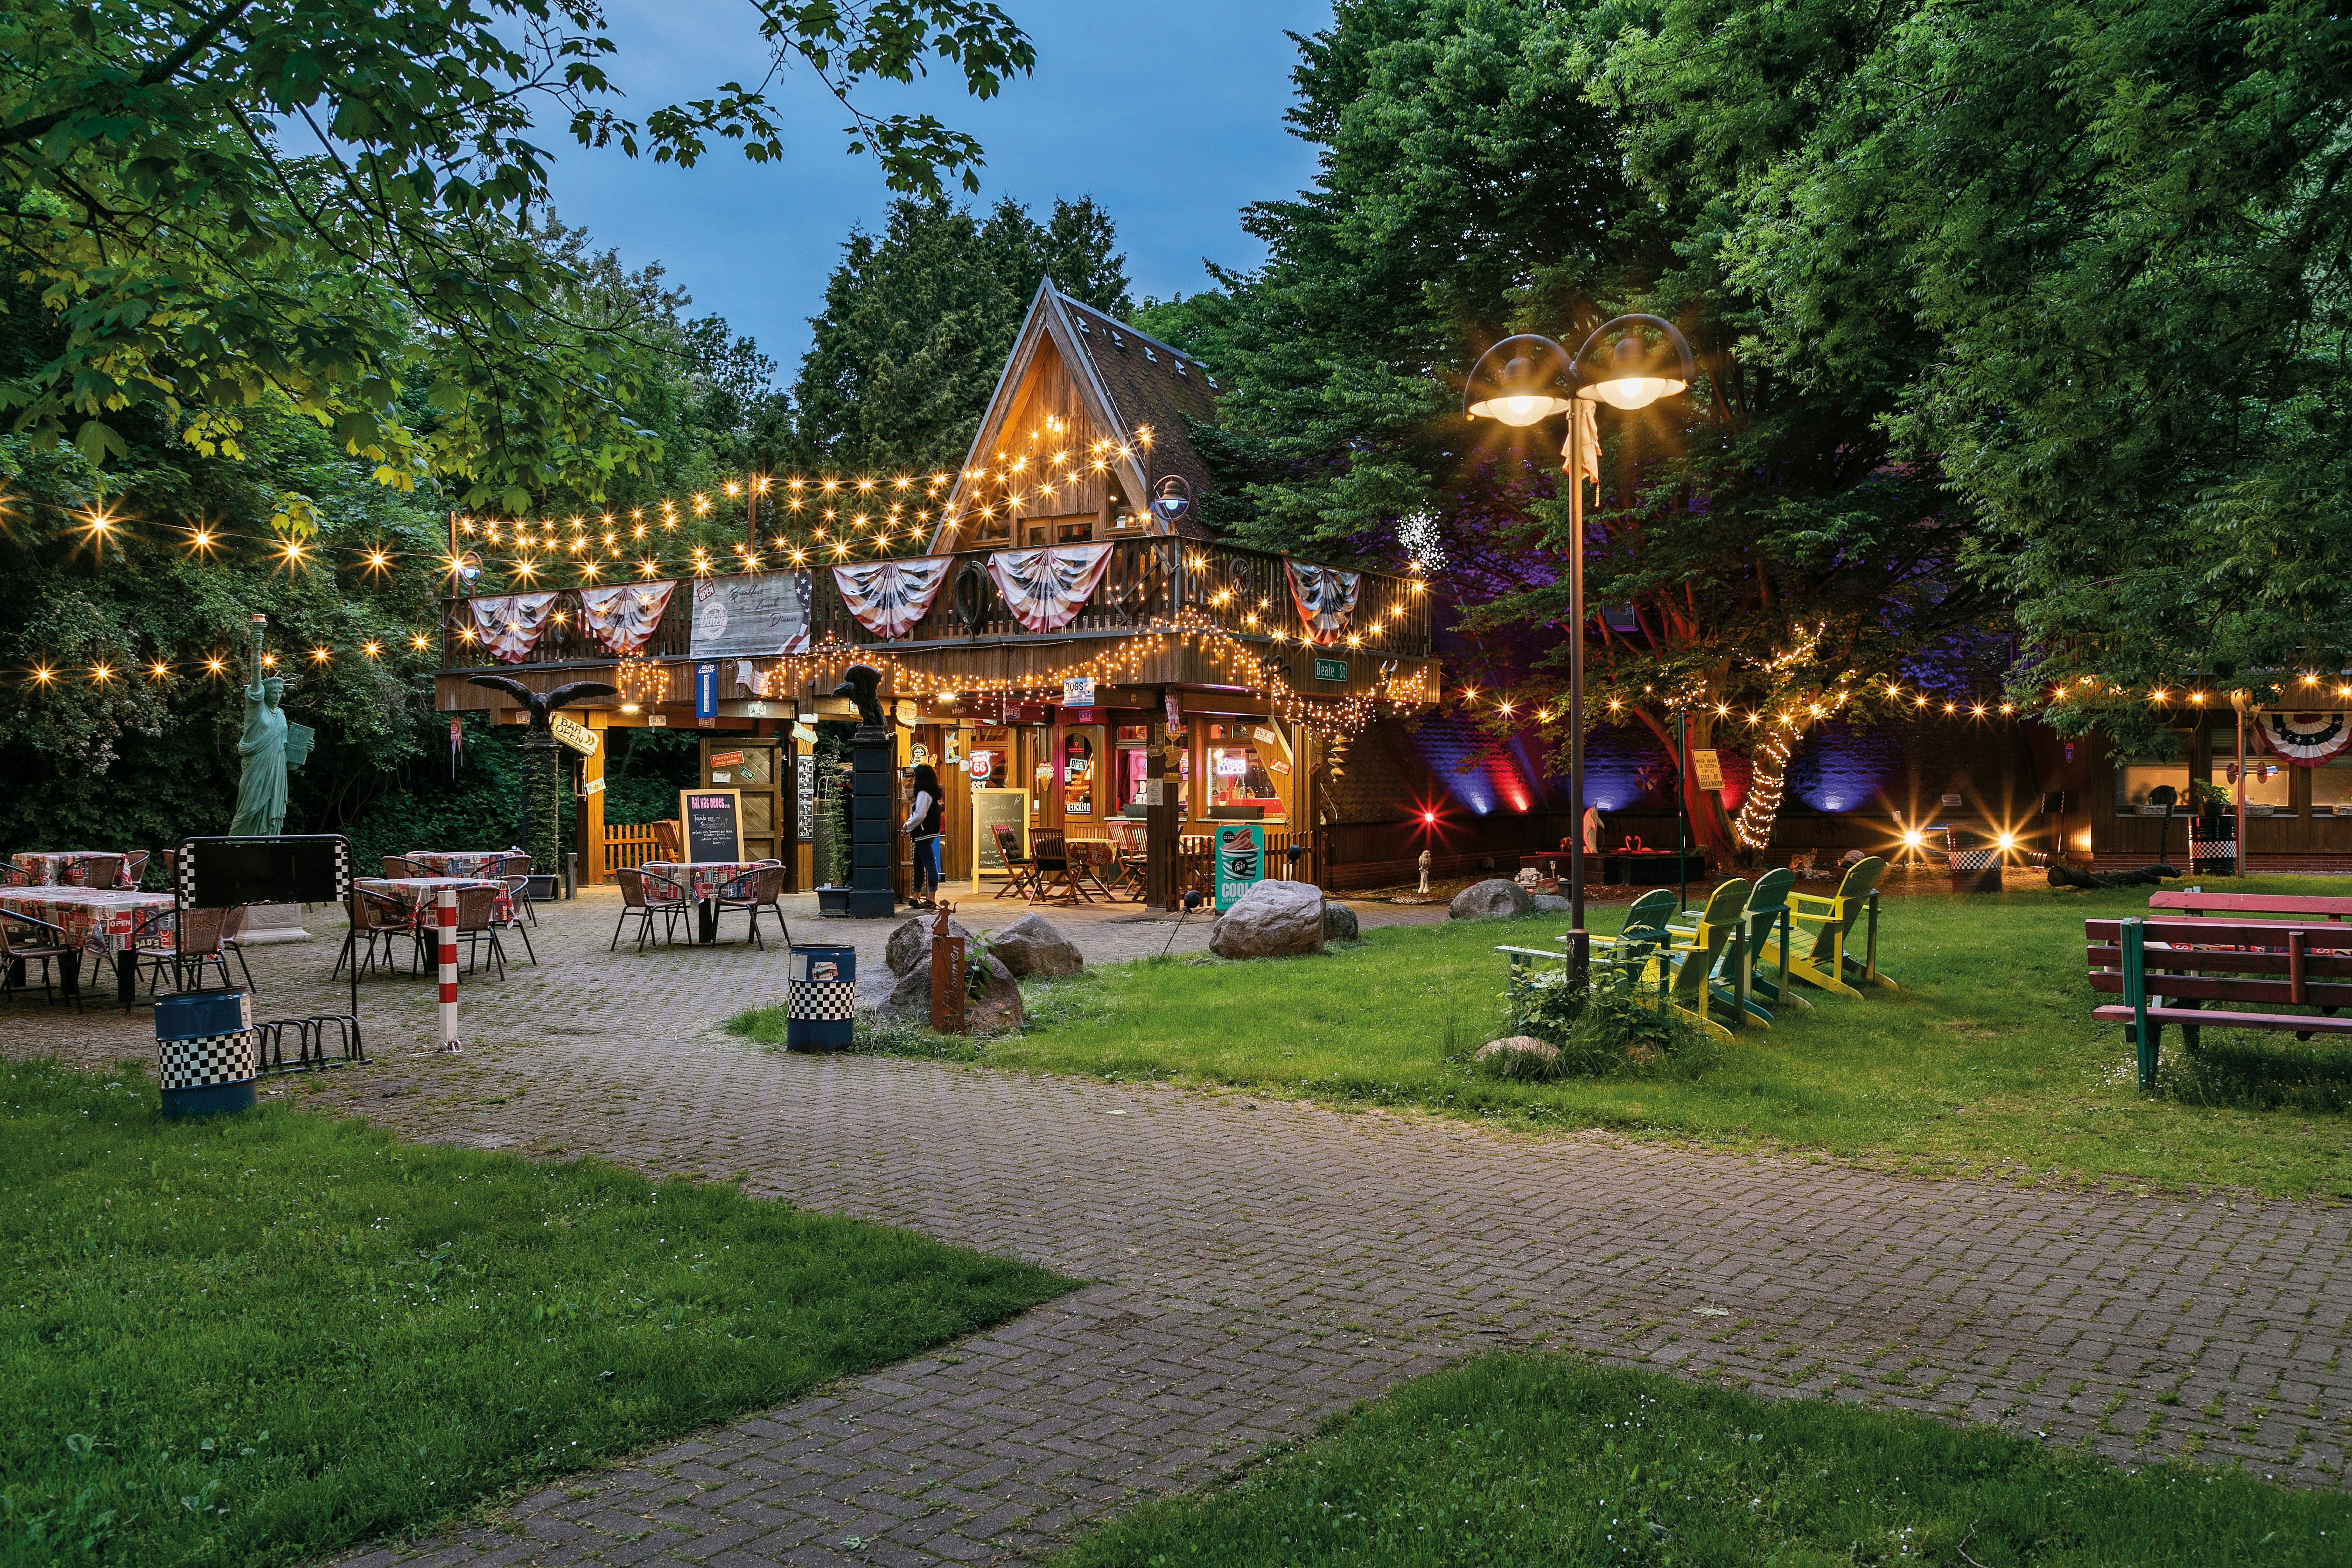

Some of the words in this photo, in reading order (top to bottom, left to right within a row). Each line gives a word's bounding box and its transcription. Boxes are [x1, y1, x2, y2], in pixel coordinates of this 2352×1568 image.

[699, 585, 714, 601] OPEN
[729, 585, 764, 601] Breakfast
[755, 597, 779, 610] Lunch
[700, 614, 725, 627] Diner
[768, 612, 797, 627] Dinner
[1317, 662, 1334, 677] Beale
[1339, 664, 1345, 678] St
[1066, 682, 1083, 691] DOGS
[562, 717, 581, 734] BAR
[555, 724, 583, 743] OPEN
[973, 762, 986, 772] 66
[1071, 760, 1086, 769] OPEN
[1227, 762, 1244, 770] BAR
[700, 798, 709, 809] was
